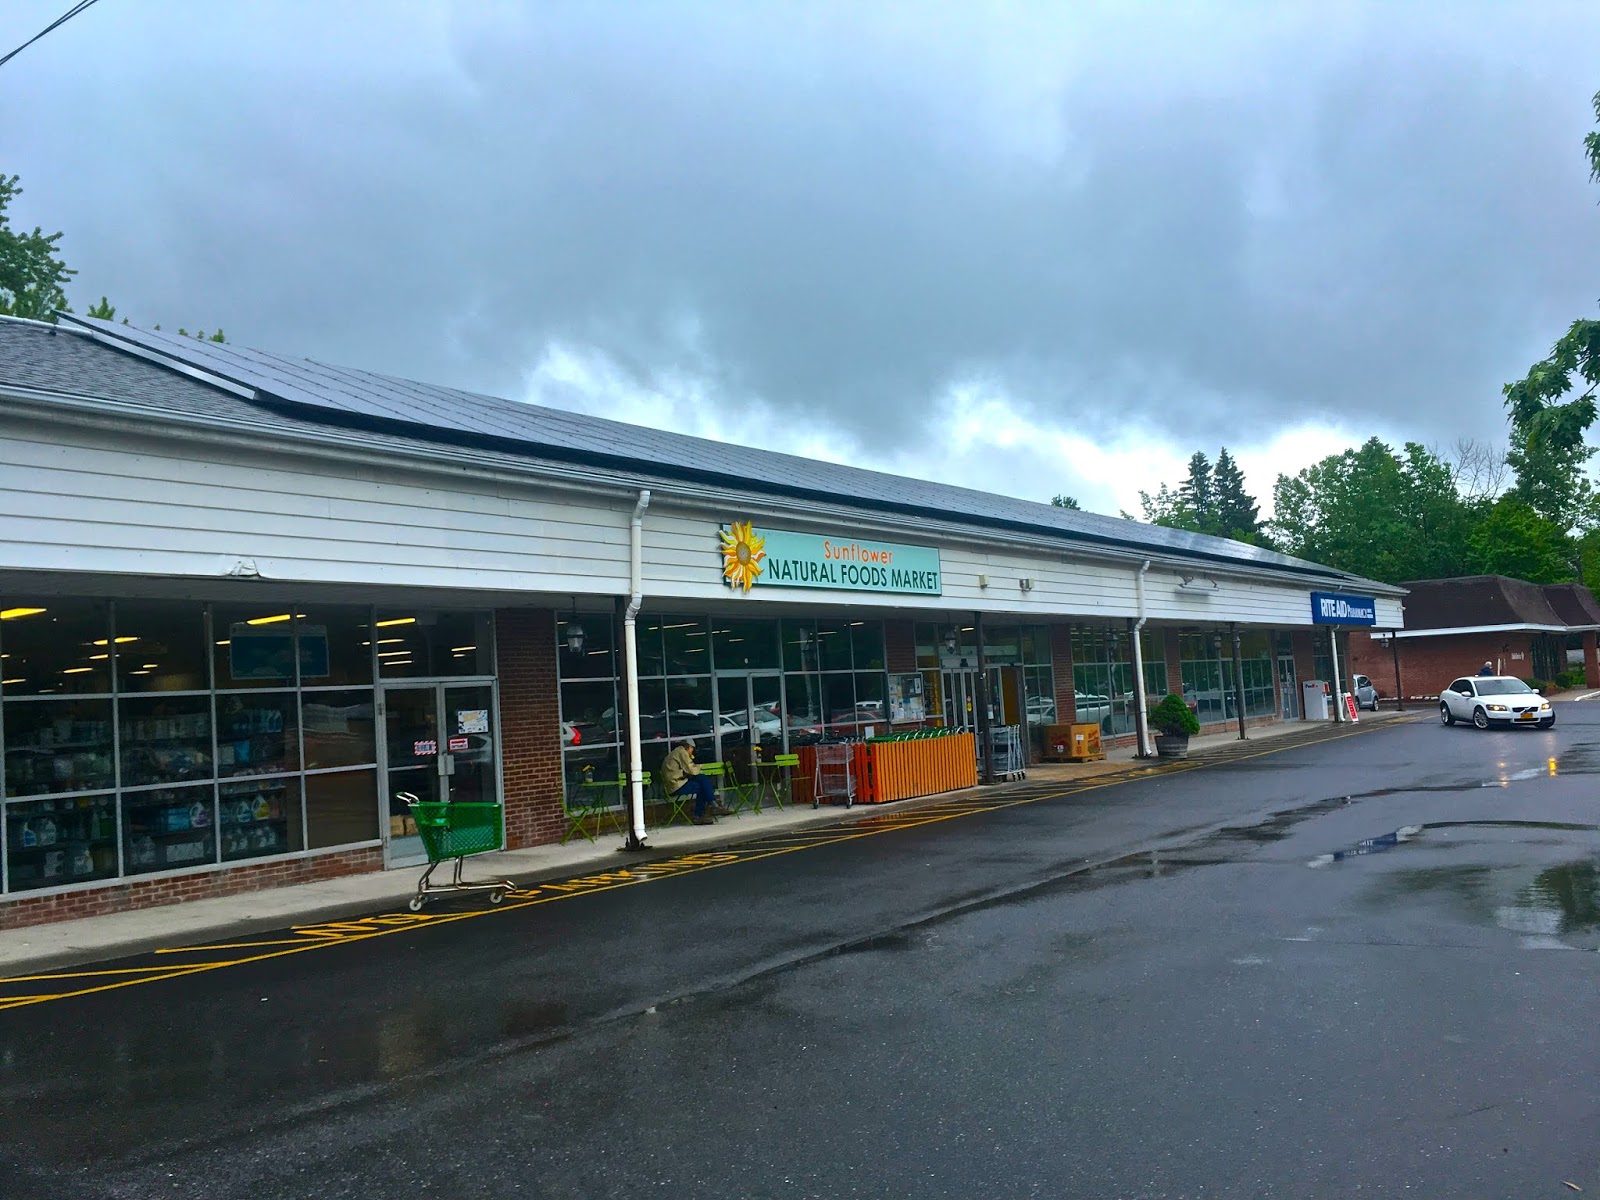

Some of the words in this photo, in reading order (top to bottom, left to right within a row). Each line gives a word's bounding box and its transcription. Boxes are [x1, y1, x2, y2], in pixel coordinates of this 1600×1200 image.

[823, 540, 893, 564] Sunflower
[768, 558, 837, 584] NATURAL
[841, 564, 888, 587] FOODS
[891, 568, 938, 590] MARKET
[1320, 598, 1336, 617] RITE
[1336, 600, 1347, 618] AID
